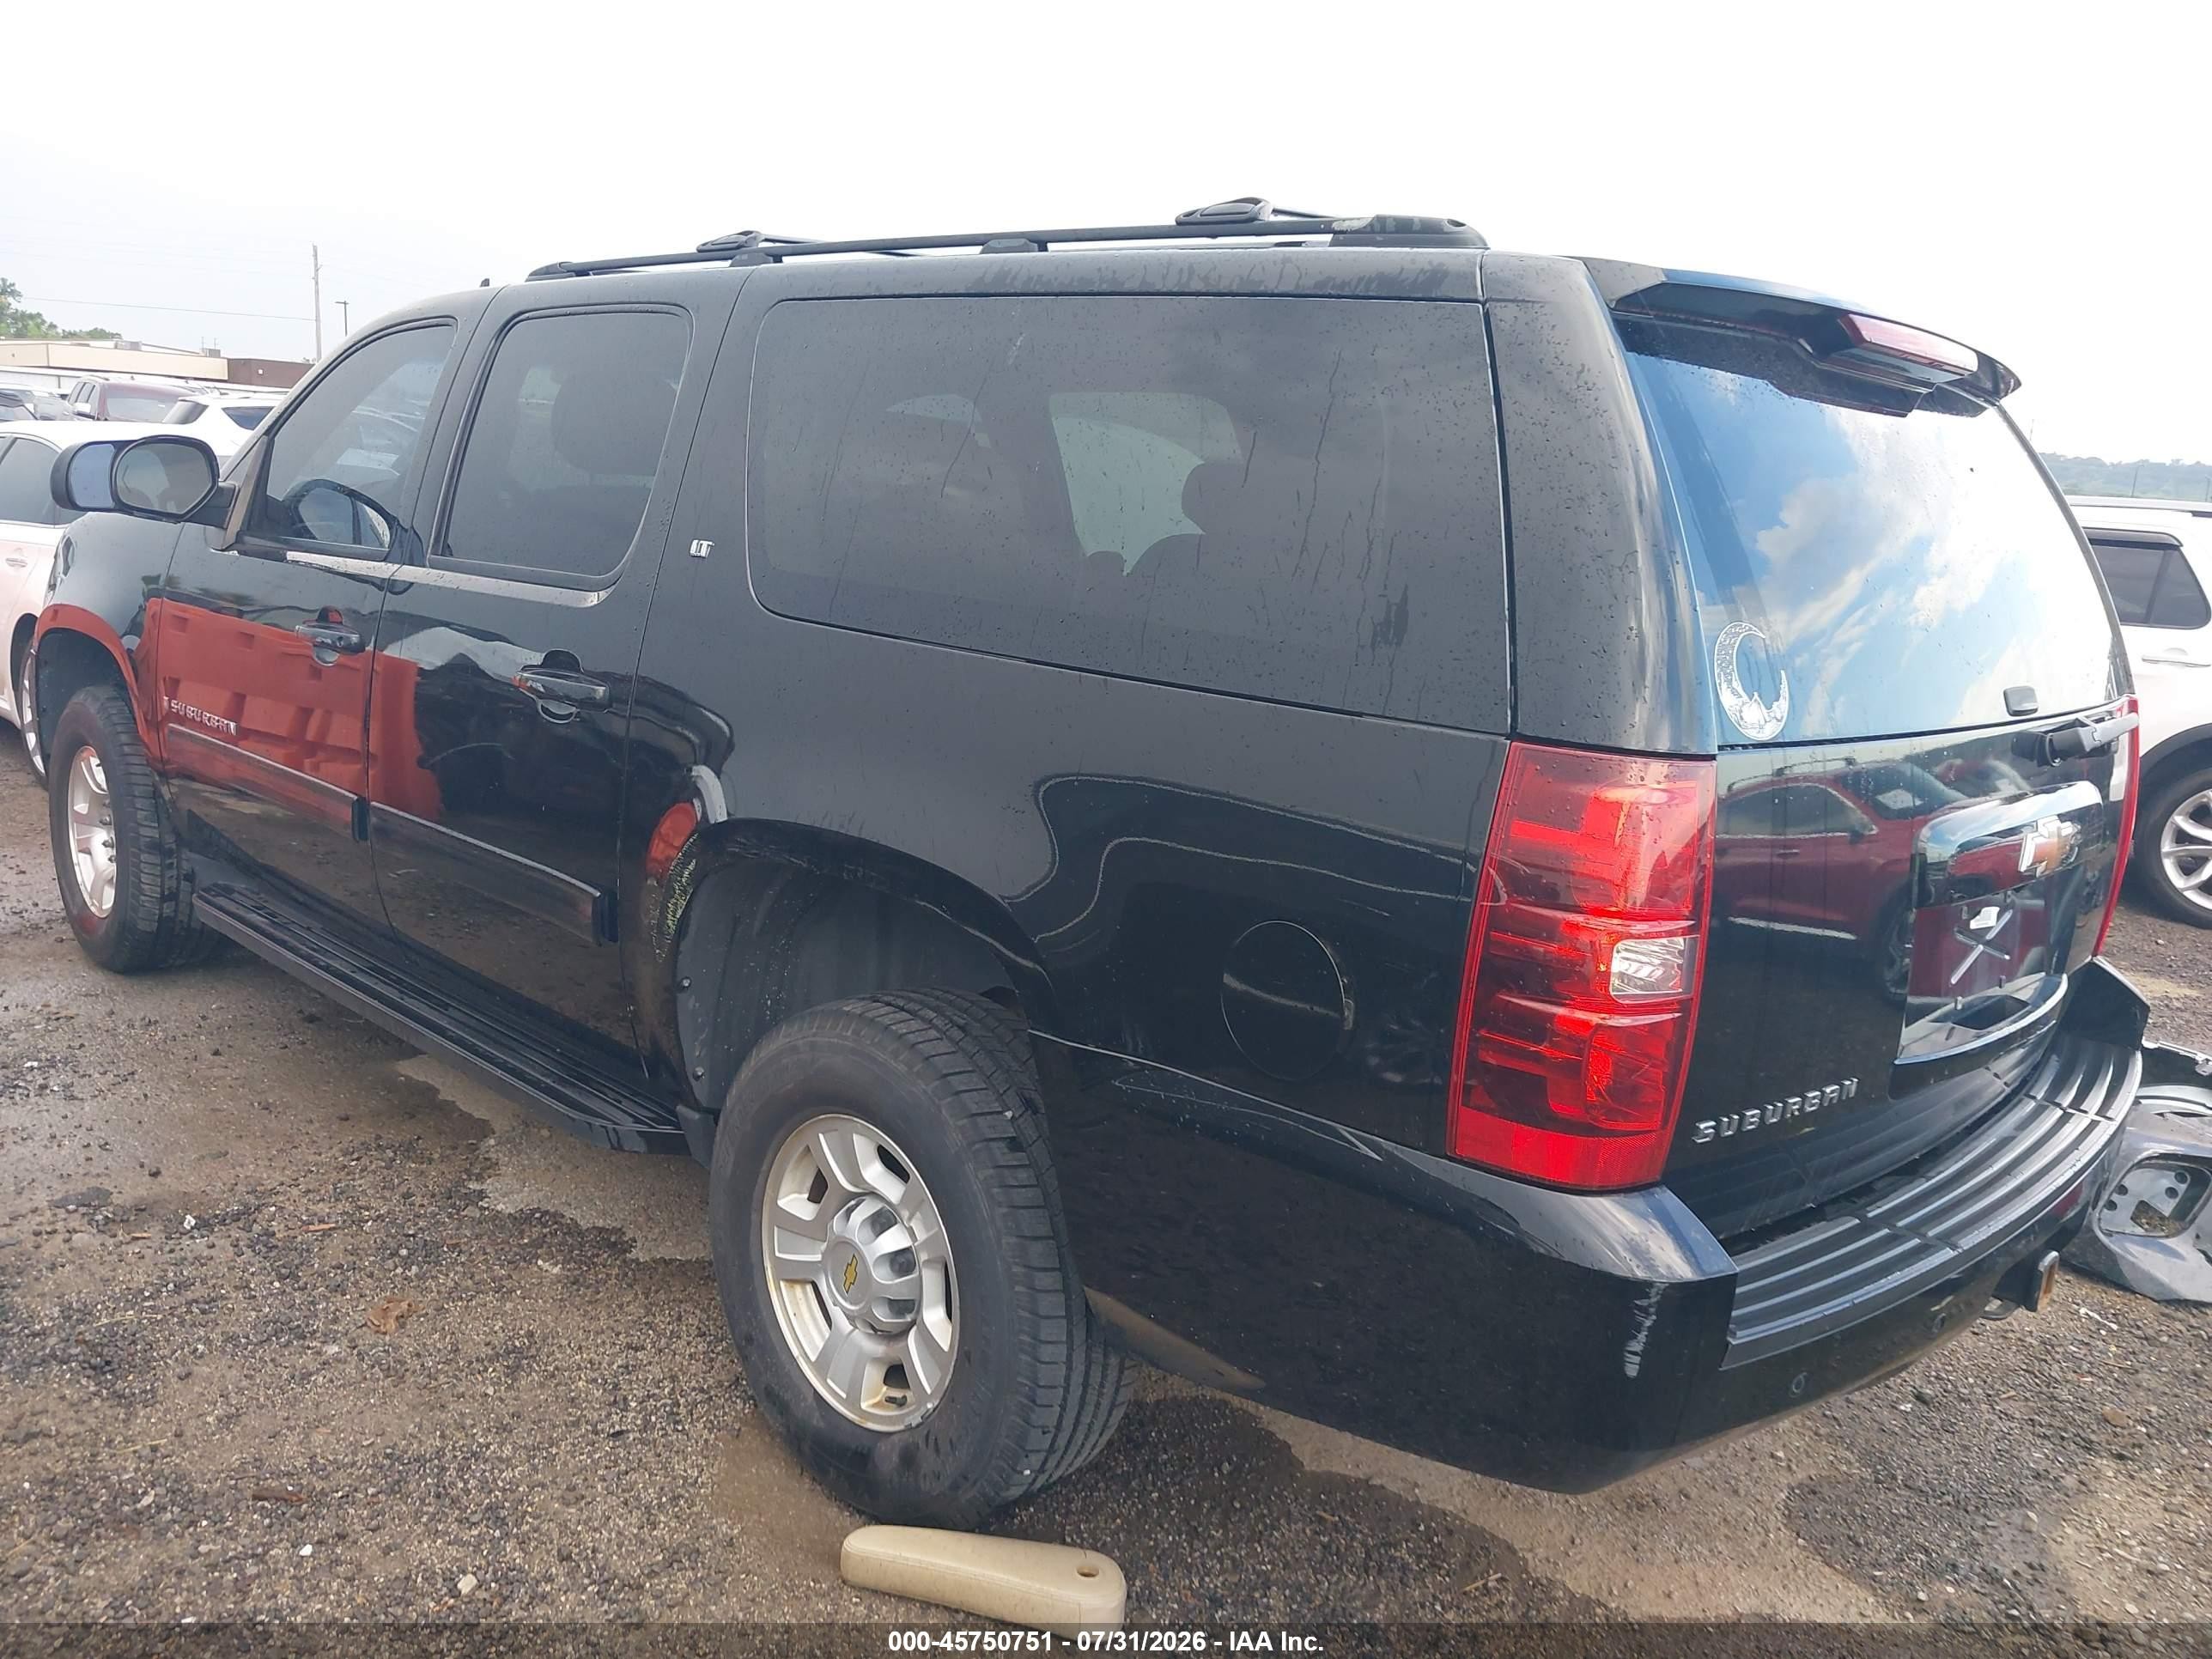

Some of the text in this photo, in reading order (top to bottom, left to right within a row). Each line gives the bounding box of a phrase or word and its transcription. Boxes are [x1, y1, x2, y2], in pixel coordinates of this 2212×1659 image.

[690, 539, 715, 558] LT
[170, 699, 238, 736] SUBURBAN
[1691, 1077, 1859, 1144] SUBURBAN
